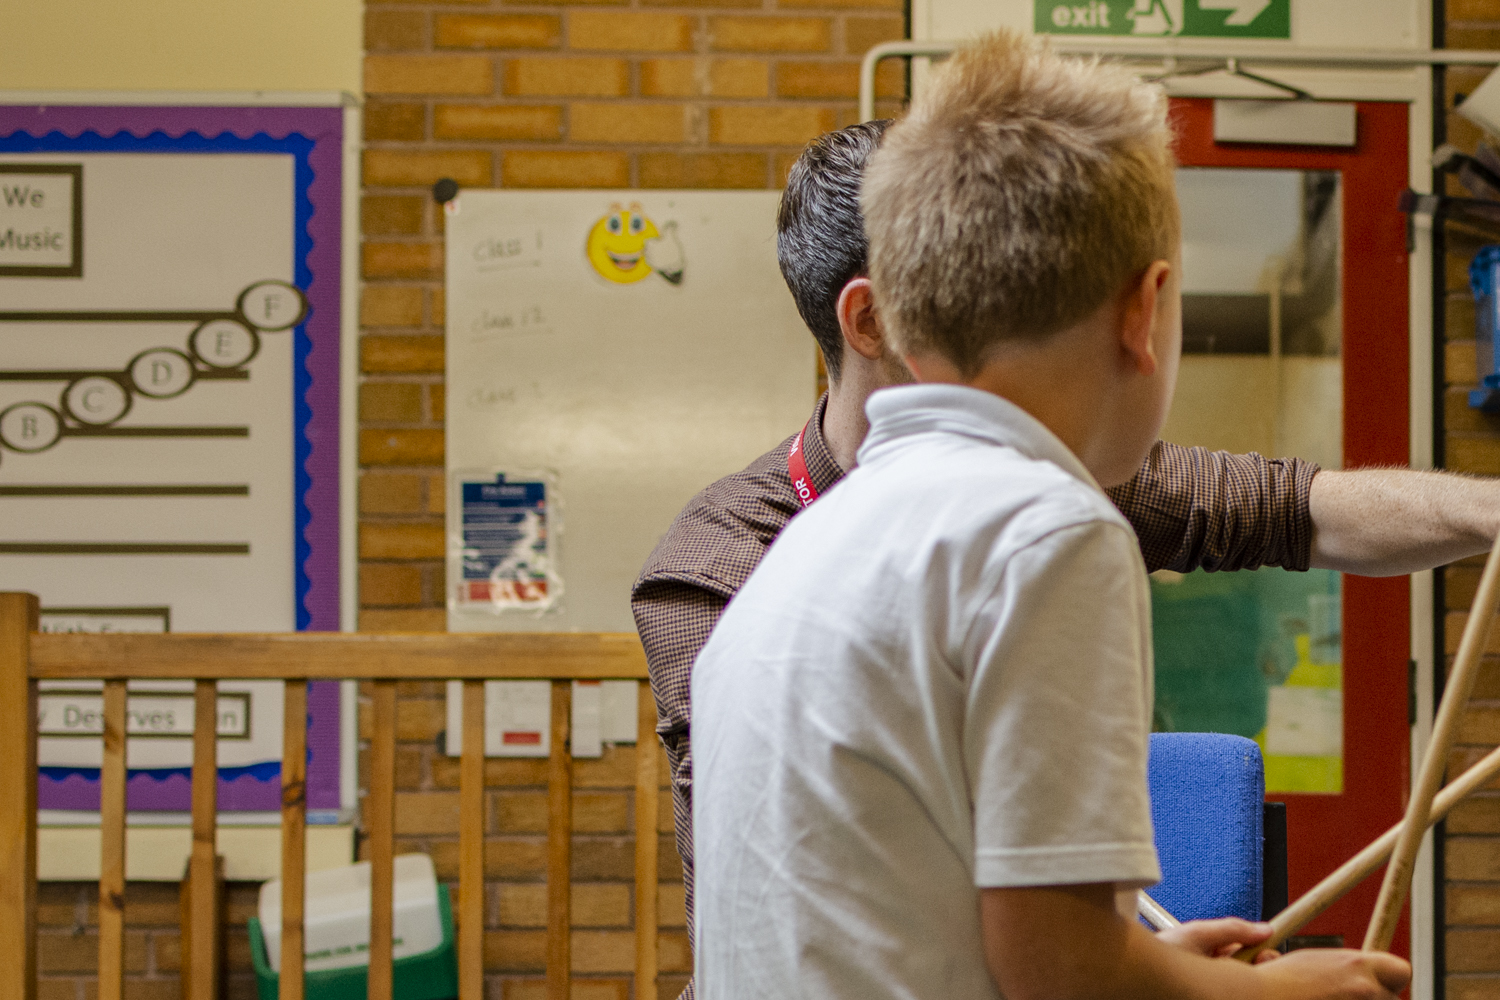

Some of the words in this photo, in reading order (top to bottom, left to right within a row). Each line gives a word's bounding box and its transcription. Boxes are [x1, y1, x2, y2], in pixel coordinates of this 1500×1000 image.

[1051, 1, 1110, 28] exit
[2, 186, 44, 207] We
[264, 294, 281, 320] F
[215, 331, 233, 357] E
[151, 360, 173, 386] D
[82, 386, 106, 413] C
